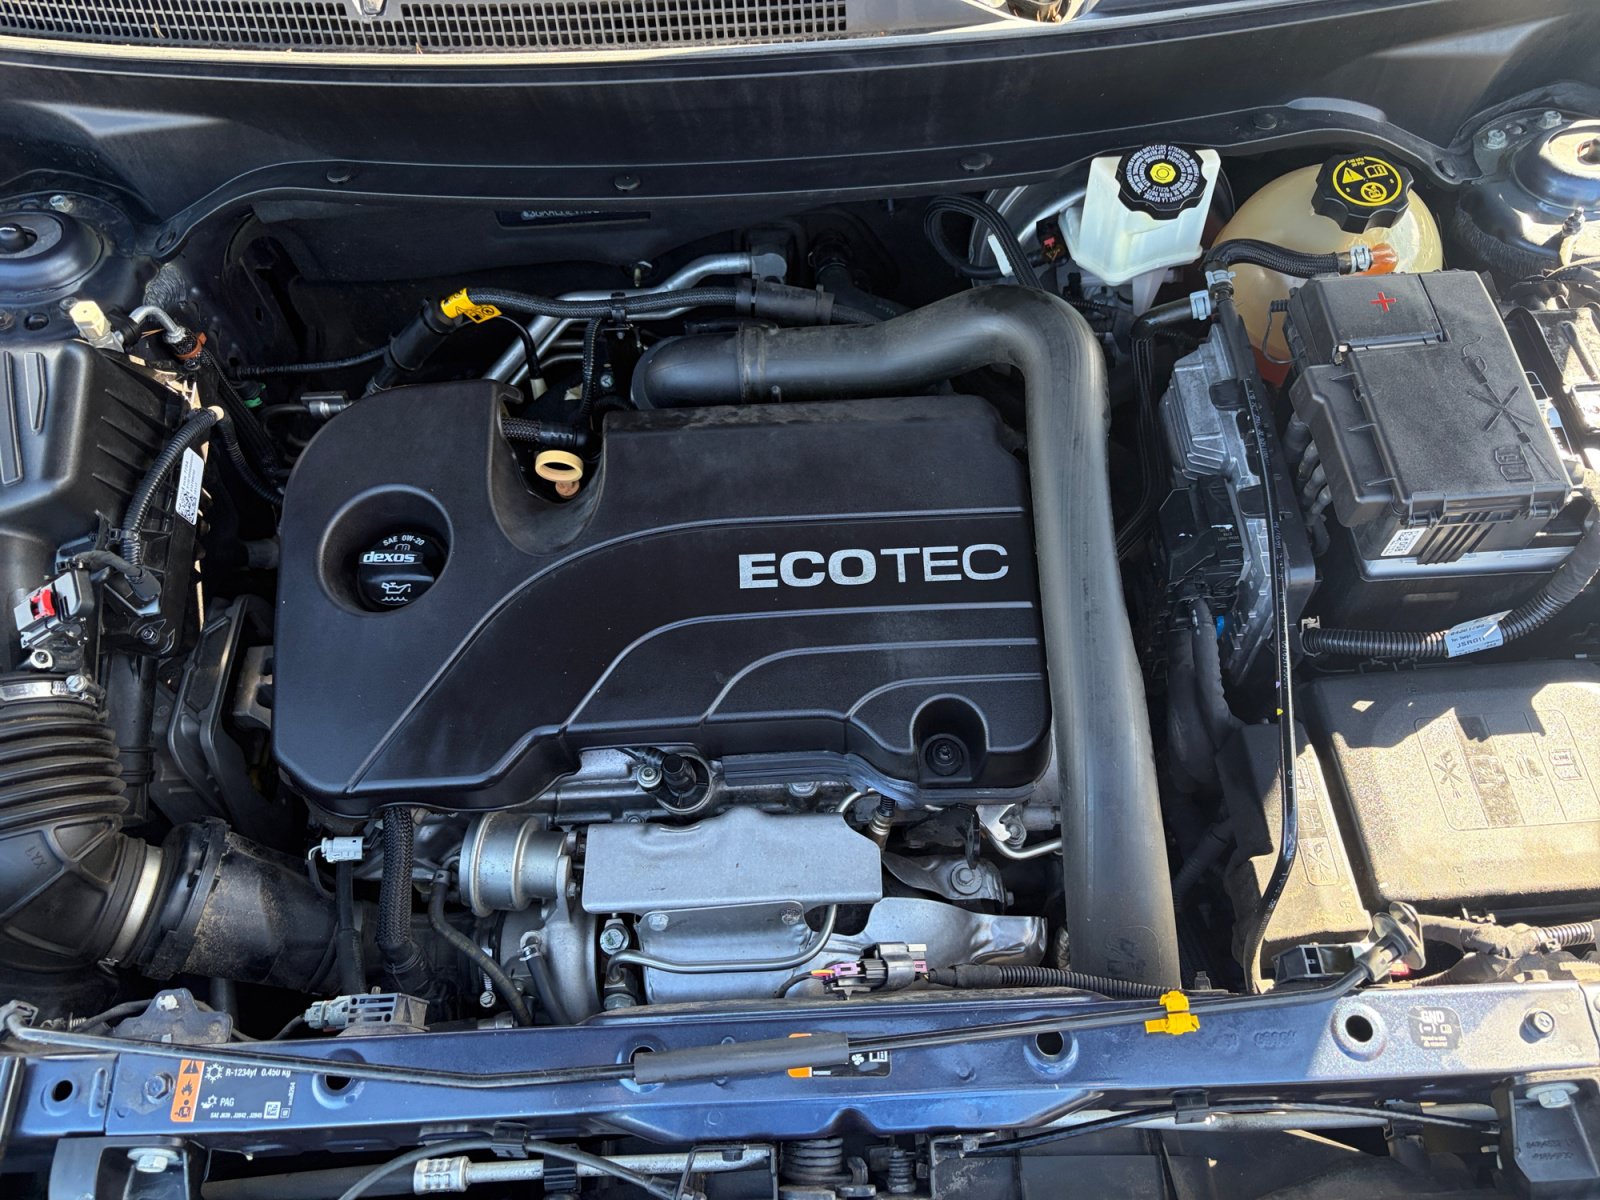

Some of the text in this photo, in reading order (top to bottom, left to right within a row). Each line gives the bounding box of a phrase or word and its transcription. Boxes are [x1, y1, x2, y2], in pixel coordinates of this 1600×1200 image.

[383, 534, 425, 546] SAE 0W-20
[362, 551, 417, 563] dexos
[738, 543, 1009, 590] ECOTEC
[1420, 1010, 1445, 1024] GND
[225, 1068, 257, 1078] R-1234yf
[220, 1098, 234, 1106] PAG
